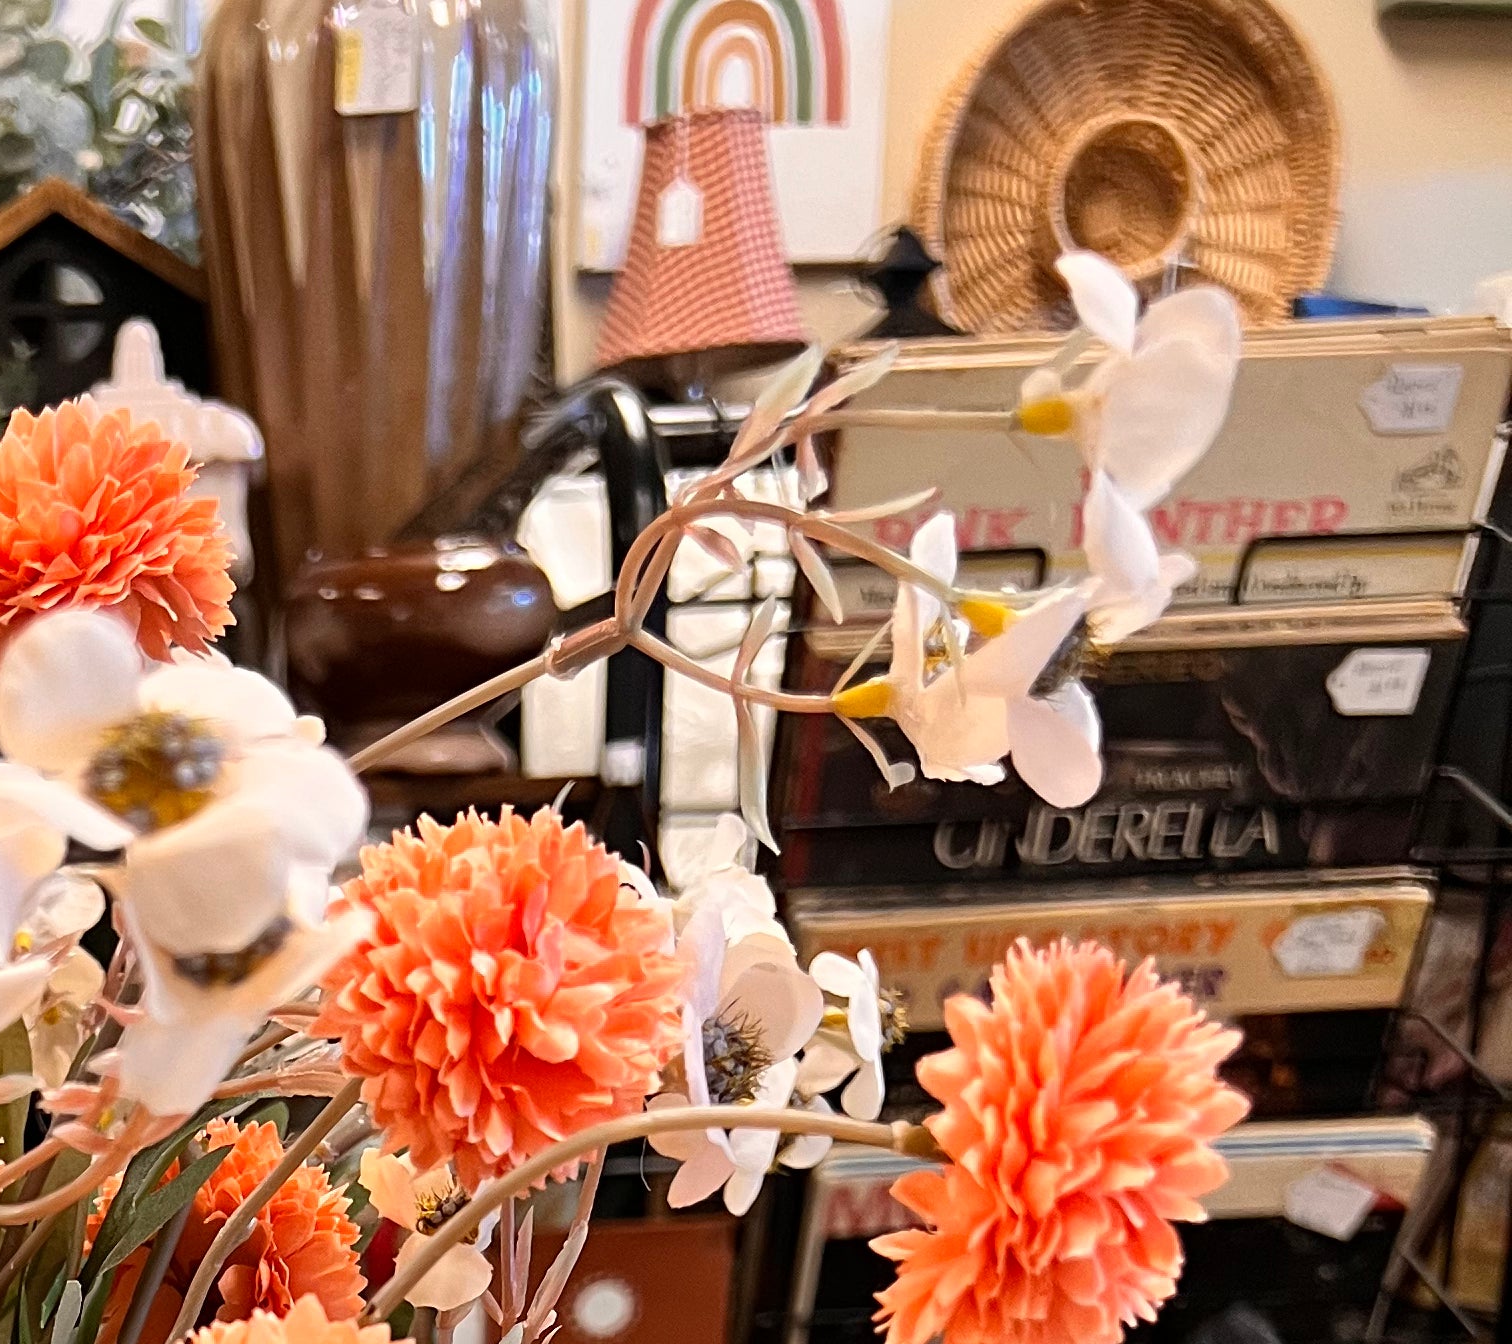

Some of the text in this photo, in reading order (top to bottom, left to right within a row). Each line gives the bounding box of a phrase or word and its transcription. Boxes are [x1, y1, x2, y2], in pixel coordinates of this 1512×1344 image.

[873, 494, 1349, 550] PNK PNTHER
[933, 801, 1280, 870] CINDERELLA
